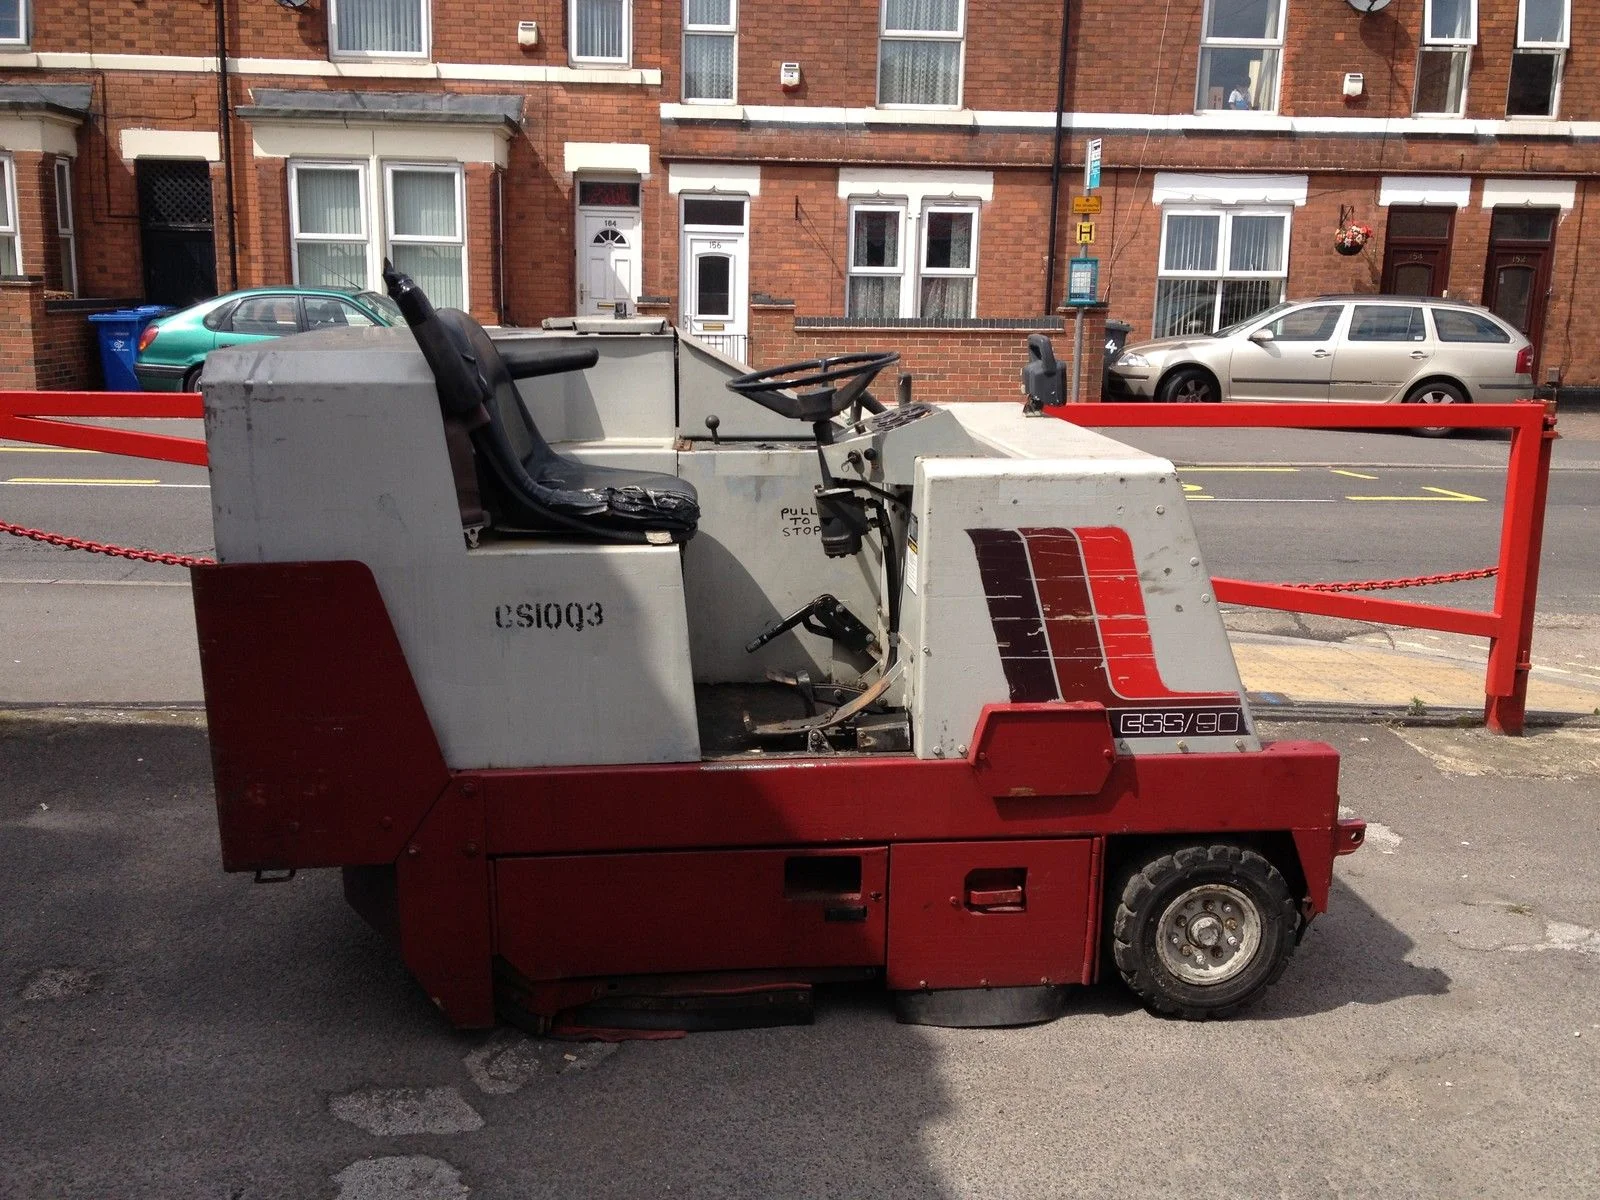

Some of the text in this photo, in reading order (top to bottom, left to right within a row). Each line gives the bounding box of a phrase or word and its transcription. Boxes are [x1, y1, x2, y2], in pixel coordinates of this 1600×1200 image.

[1079, 224, 1093, 241] H
[708, 240, 722, 250] 156
[1105, 339, 1118, 354] 4
[781, 507, 818, 520] PULL
[789, 517, 811, 526] TO
[782, 525, 822, 537] STOP
